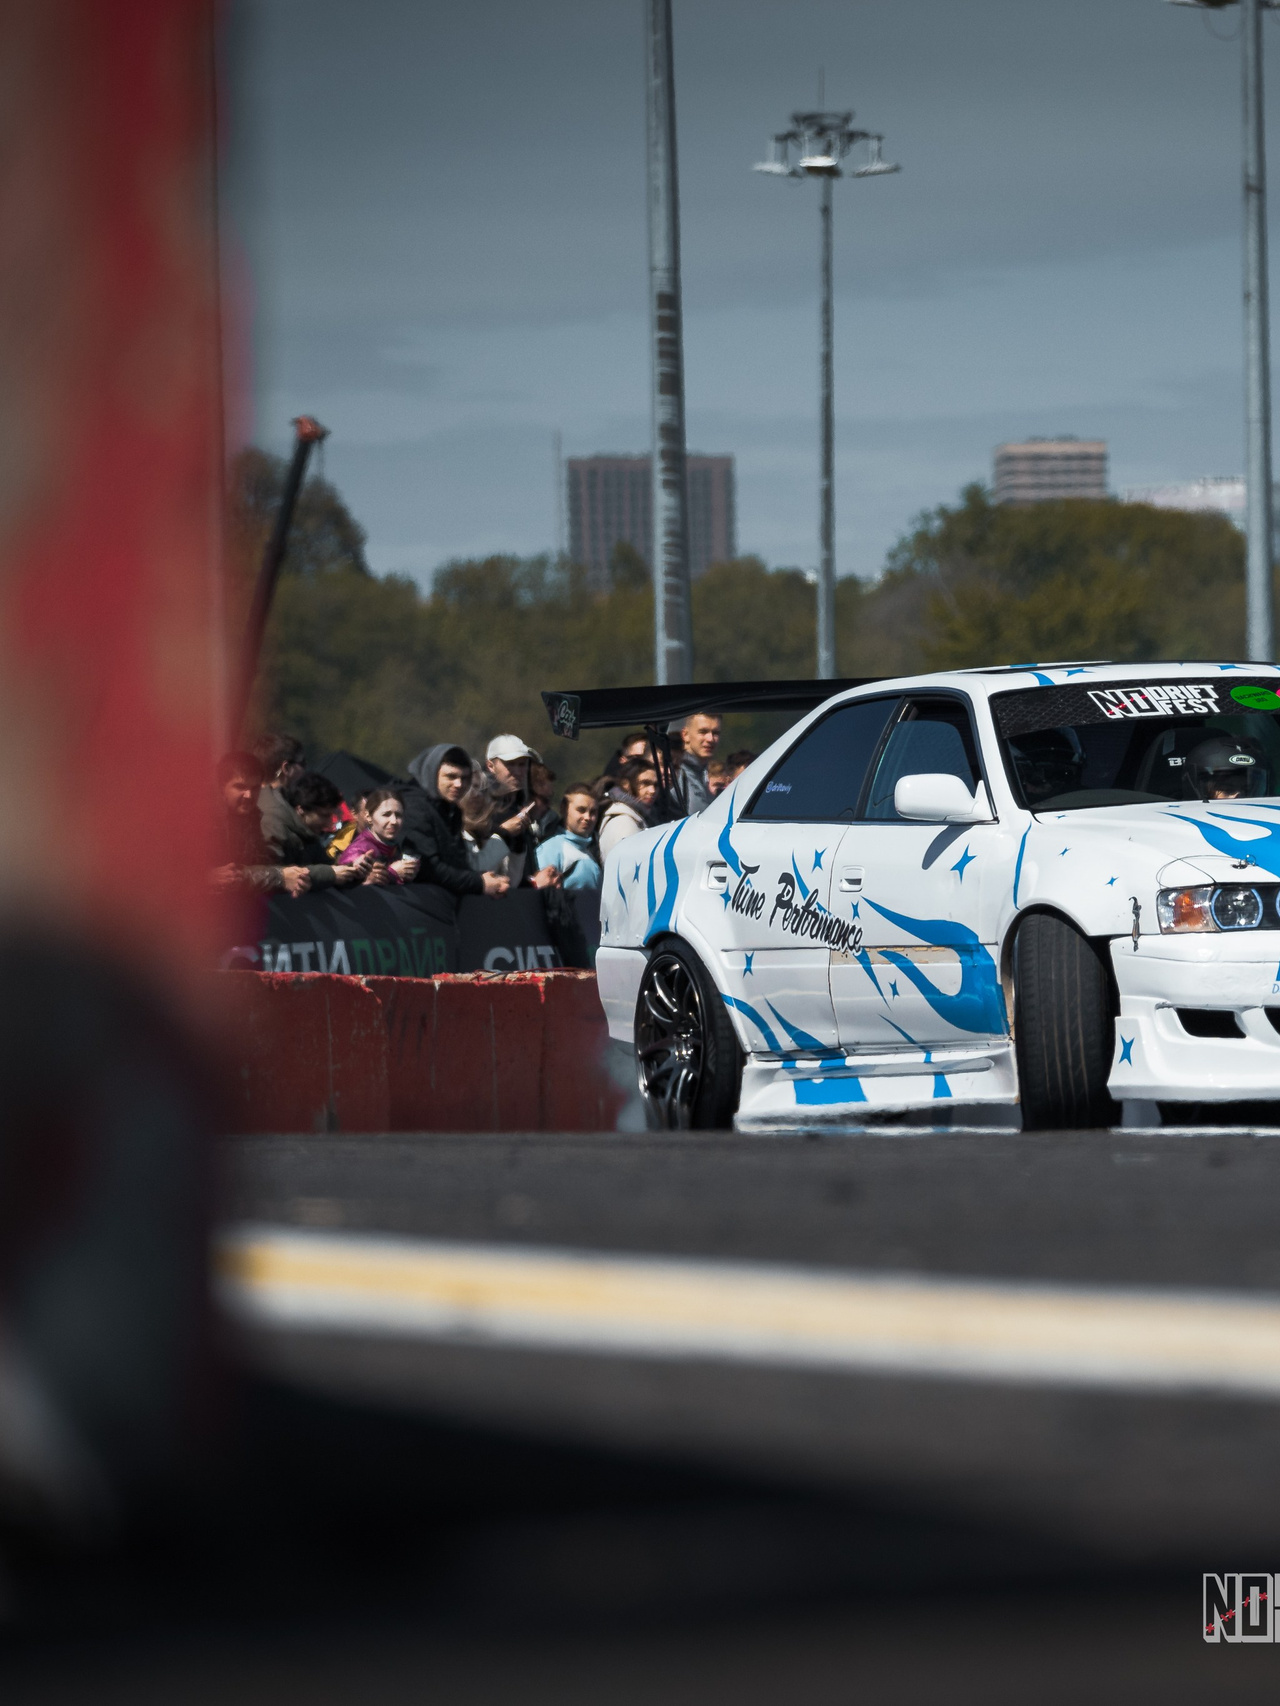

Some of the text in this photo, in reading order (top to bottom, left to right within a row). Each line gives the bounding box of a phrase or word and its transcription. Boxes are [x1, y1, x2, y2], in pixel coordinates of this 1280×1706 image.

[1145, 685, 1220, 700] DRIFT
[1157, 699, 1221, 715] FEST
[769, 872, 863, 953] Performance
